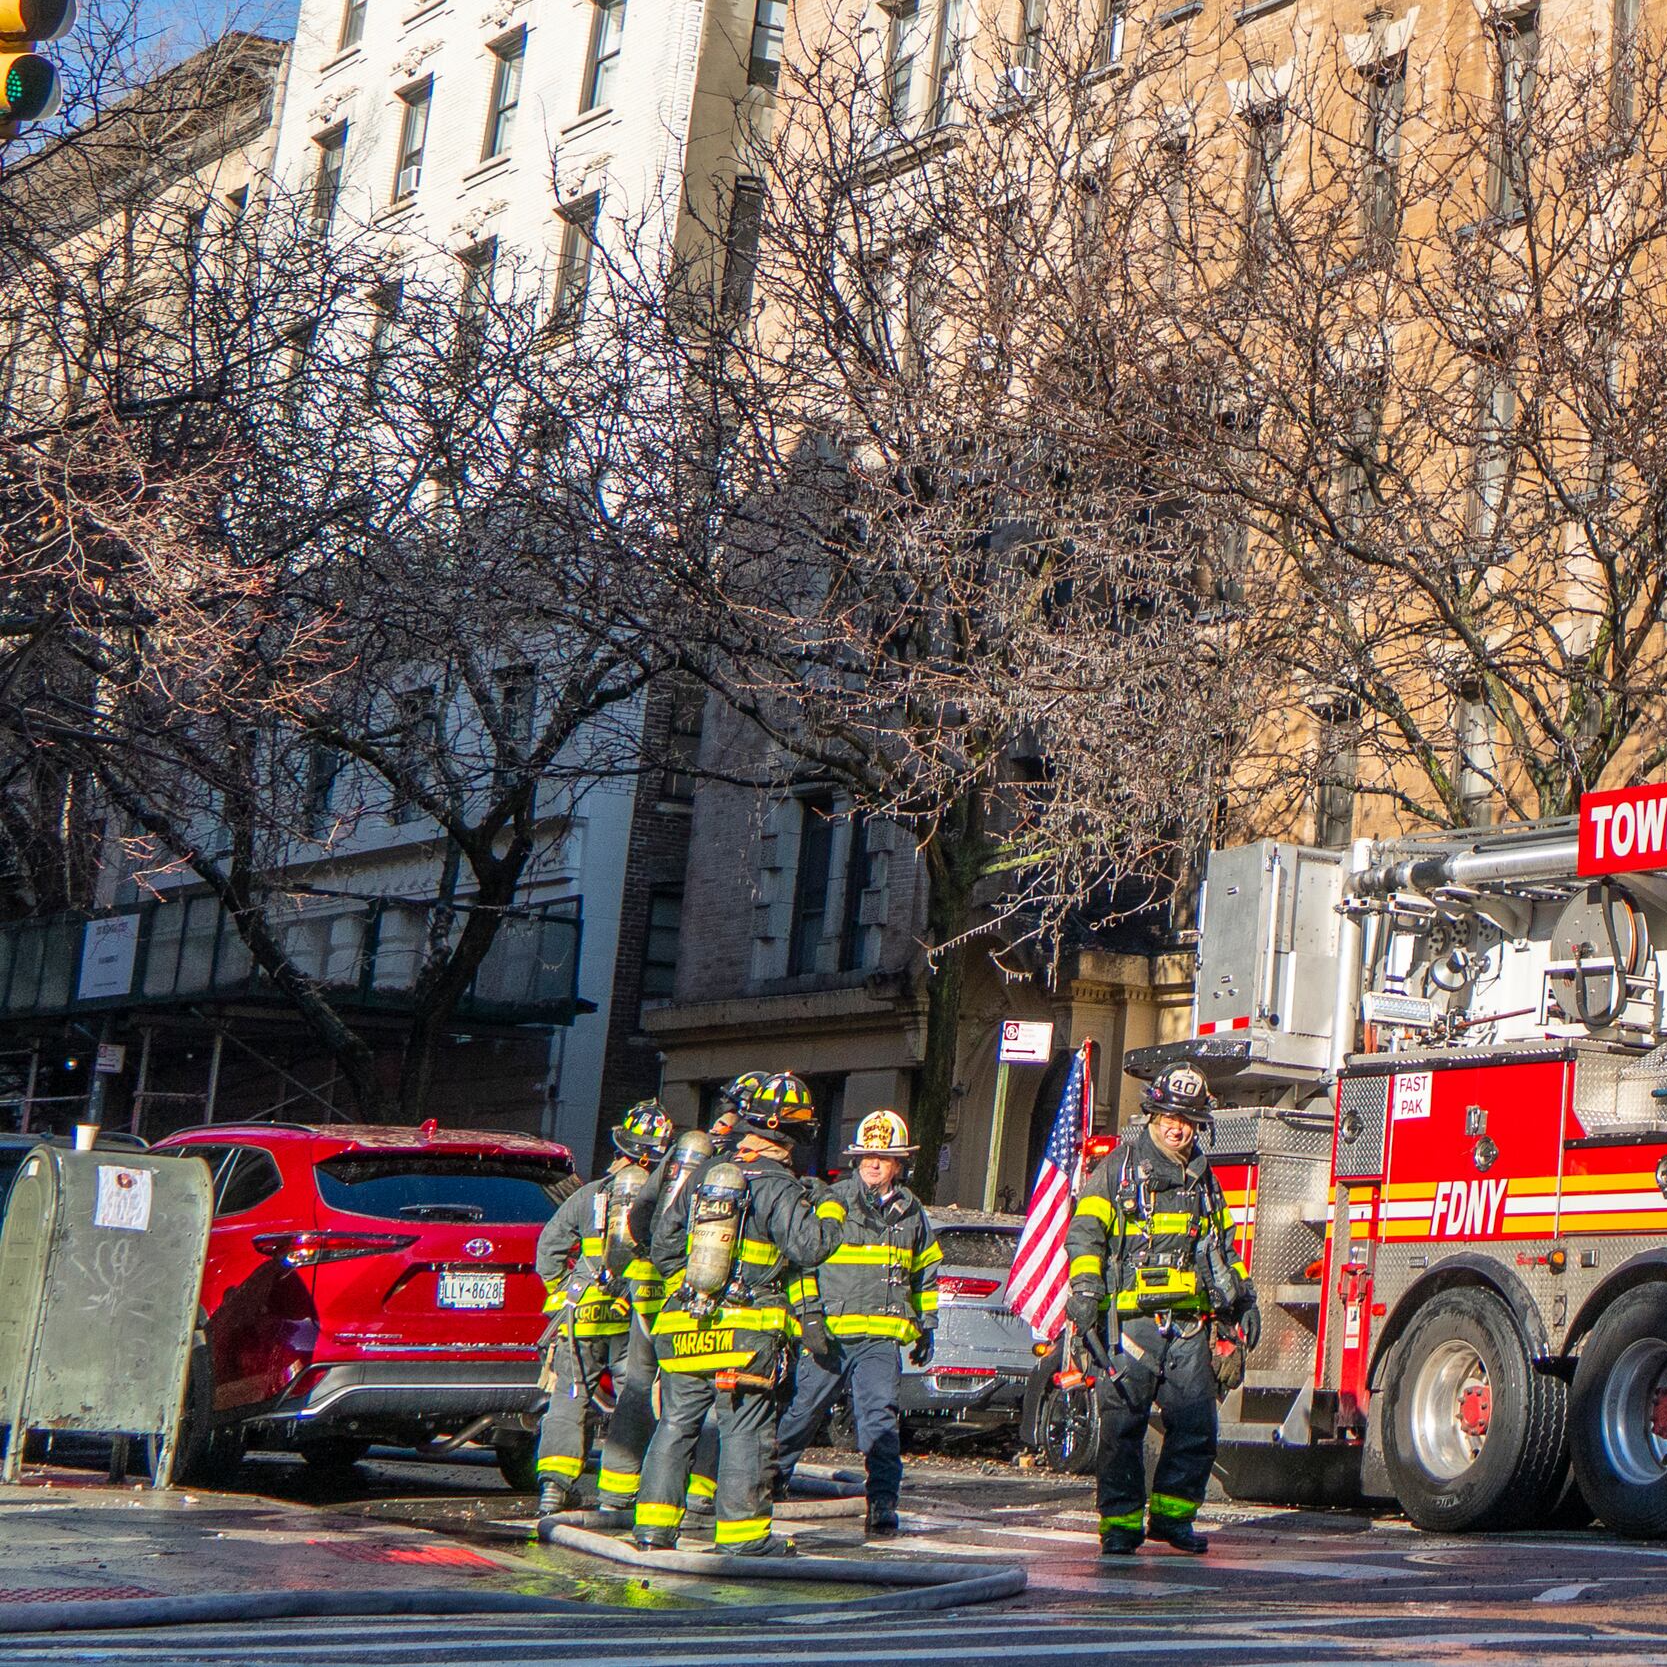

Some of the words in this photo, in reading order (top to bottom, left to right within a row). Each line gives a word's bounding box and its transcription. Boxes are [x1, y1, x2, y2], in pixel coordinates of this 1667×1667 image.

[1172, 1078, 1197, 1095] 40
[1399, 1075, 1428, 1092] FAST
[1401, 1099, 1423, 1115] PAK
[1430, 1178, 1508, 1236] FDNY
[672, 1329, 734, 1356] HARASYM
